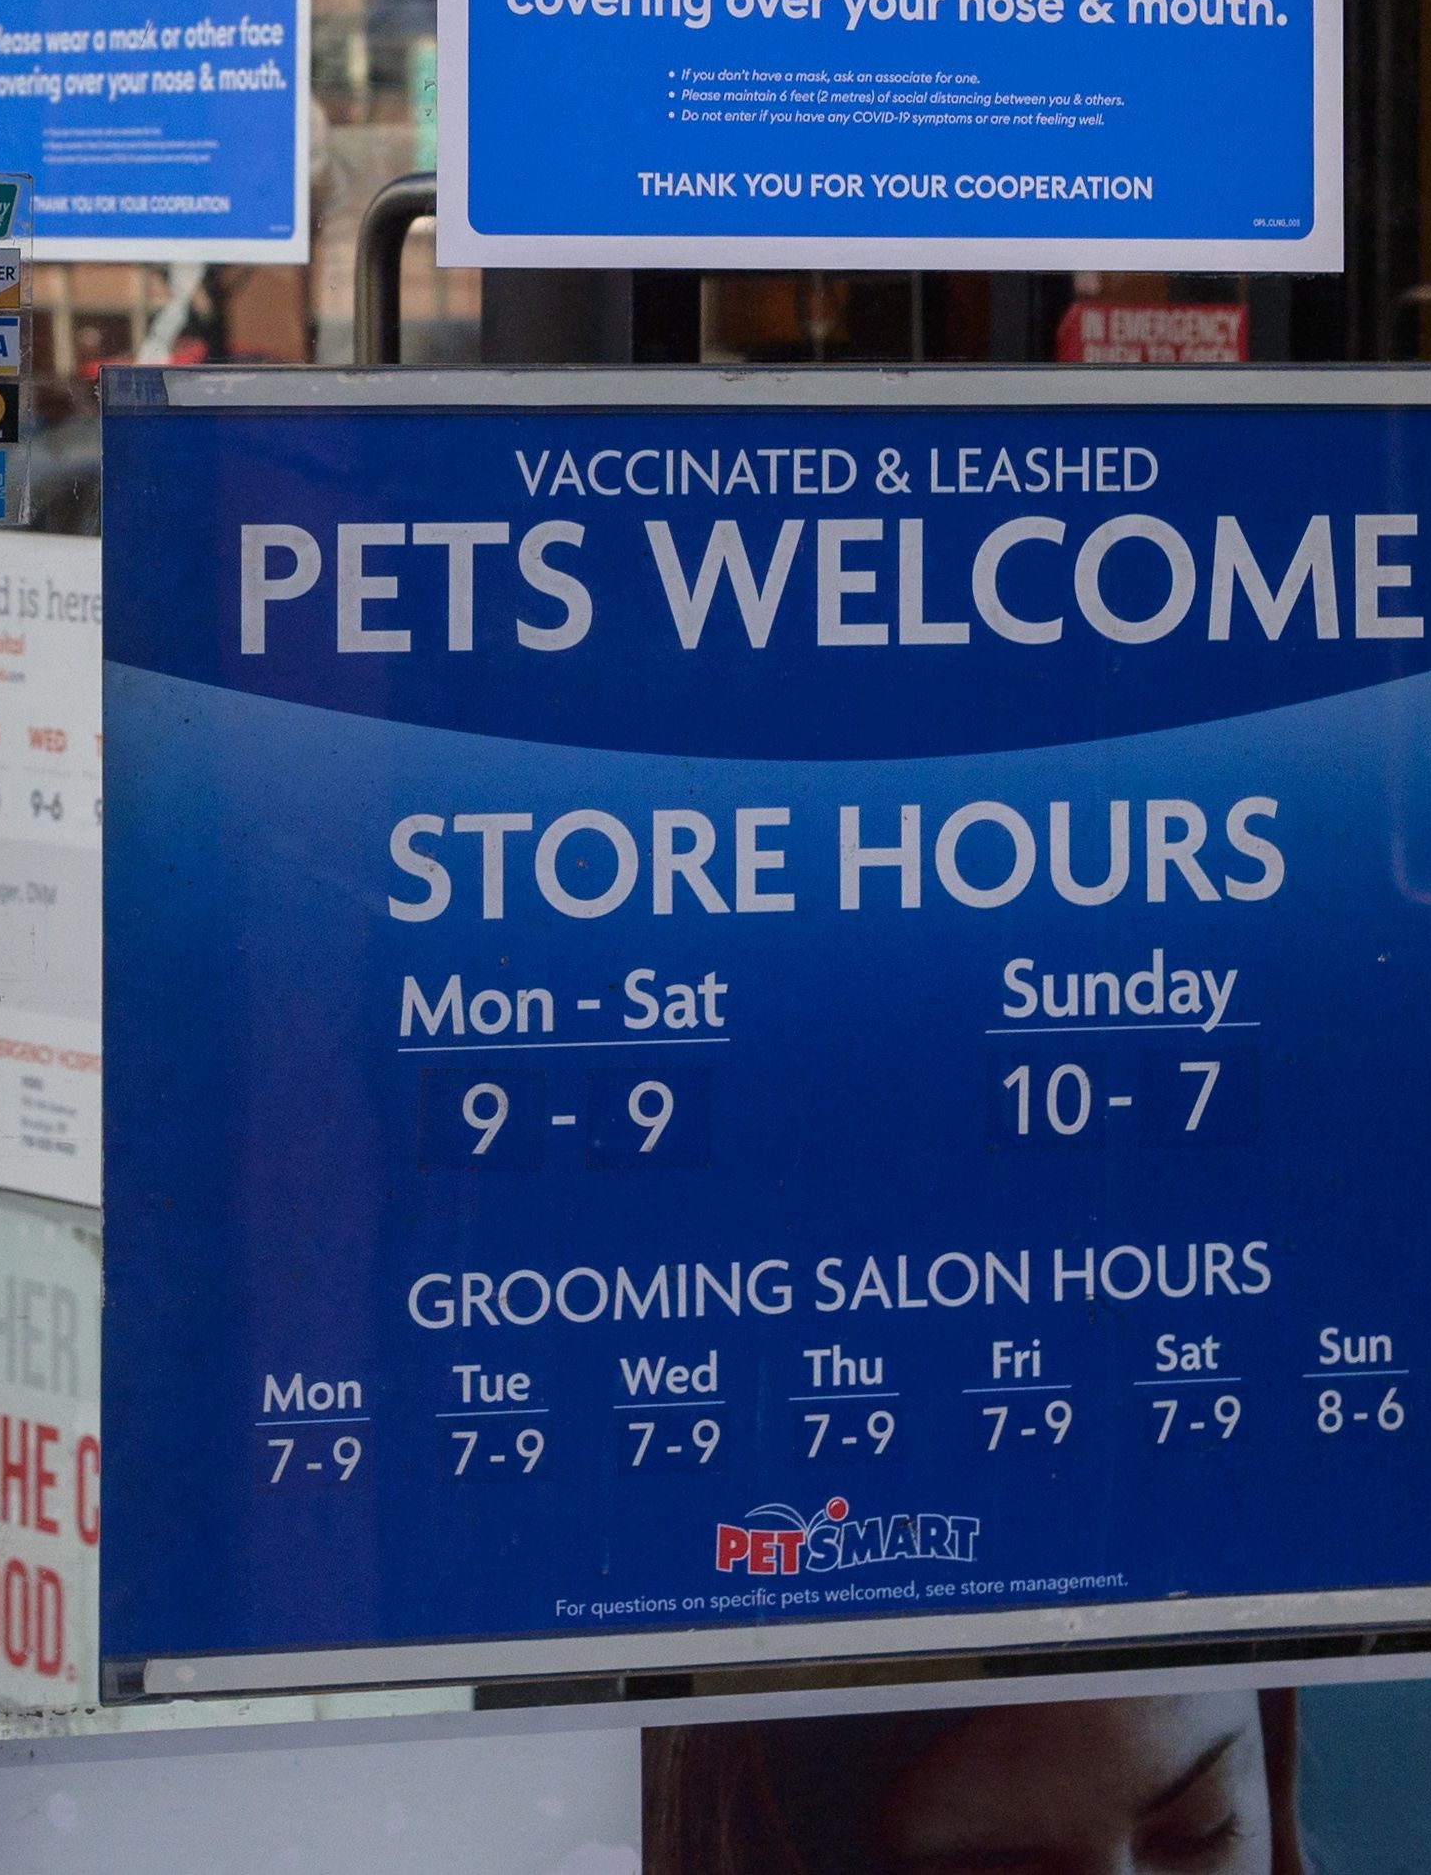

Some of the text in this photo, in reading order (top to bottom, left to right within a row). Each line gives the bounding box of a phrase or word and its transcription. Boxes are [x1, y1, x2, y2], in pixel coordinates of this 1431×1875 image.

[45, 31, 90, 53] wear
[93, 30, 106, 51] a
[109, 20, 158, 50] mask
[161, 28, 181, 49] or
[185, 18, 237, 49] other
[238, 16, 284, 46] face
[64, 73, 107, 95] over
[103, 72, 150, 101] your
[154, 70, 196, 92] nose
[199, 62, 215, 91] &
[219, 59, 287, 91] mouth.
[682, 68, 691, 80] If
[693, 72, 715, 83] you
[752, 69, 782, 81] have
[784, 73, 793, 81] a
[796, 70, 830, 83] mask,
[834, 71, 854, 82] ask
[857, 74, 872, 82] an
[875, 71, 932, 83] associate
[936, 72, 952, 83] for
[955, 75, 980, 84] one.
[682, 89, 1124, 107] Please maintain 6 feet (2 metres) of social distancing between you & others.
[682, 109, 1104, 128] Do not enter if you have any COVID-19 symptoms or are not feeling well.
[638, 173, 1152, 200] THANK YOU FOR YOUR COOPERATION
[515, 447, 1158, 496] VACCINATED & LEASHED
[18, 578, 39, 619] is
[241, 514, 1424, 654] PETS WELCOME
[388, 796, 1284, 922] STORE HOURS
[400, 969, 728, 1036] Mon - Sat
[1001, 951, 1239, 1033] Sunday
[408, 1241, 1271, 1329] GROOMING SALON HOURS
[263, 1327, 1392, 1412] Mon Tue Wed Thu Fri Sat Sun
[716, 1514, 980, 1575] PETSMART
[556, 1573, 1128, 1619] For questions on specific pets welcomed, see store management.
